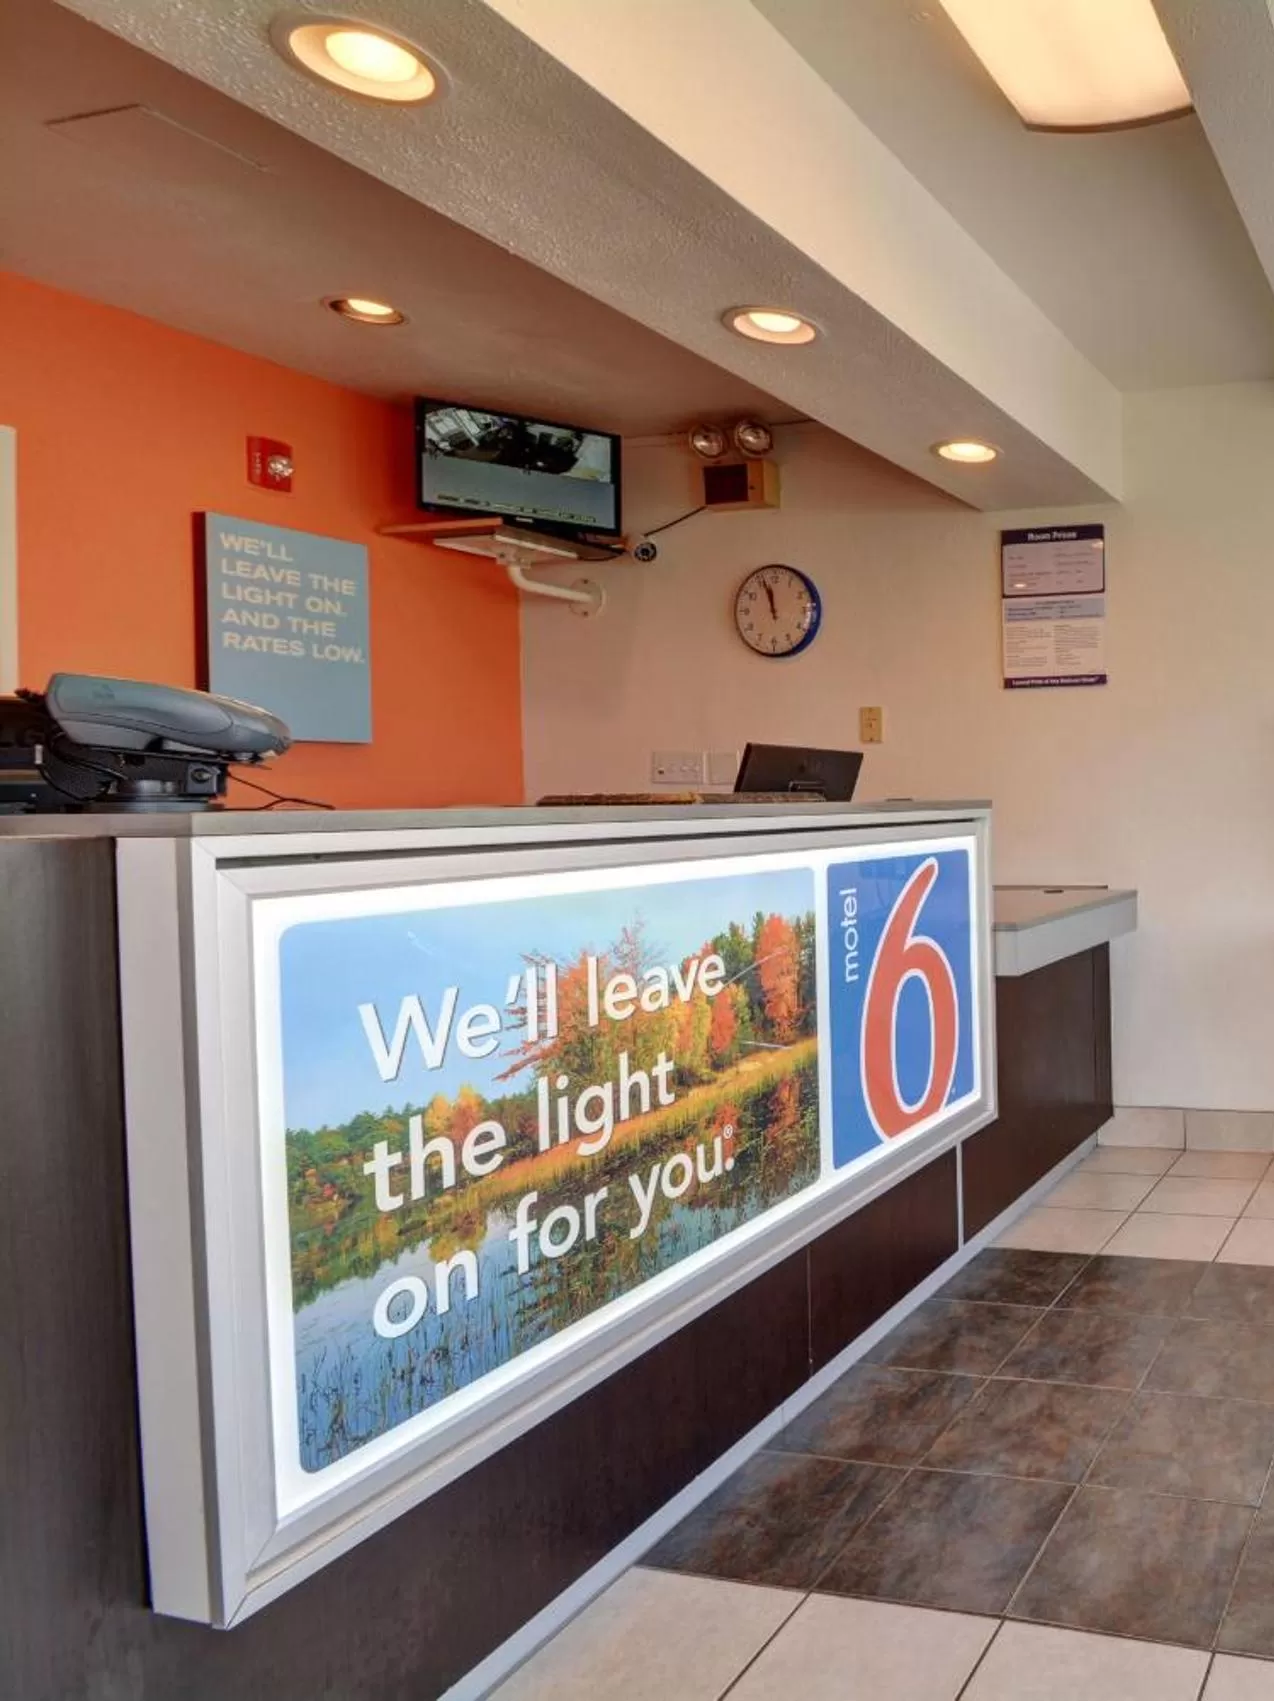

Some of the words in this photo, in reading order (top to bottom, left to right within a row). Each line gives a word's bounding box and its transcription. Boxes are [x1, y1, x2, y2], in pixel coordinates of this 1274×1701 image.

[220, 532, 294, 562] WE'LL
[221, 558, 302, 586] LEAVE
[308, 573, 357, 597] THE
[221, 583, 300, 609] LIGHT
[222, 608, 280, 630] AND
[287, 616, 337, 637] THE
[222, 632, 305, 657] RATES
[312, 643, 366, 664] LOW.
[839, 887, 858, 983] motel
[357, 960, 559, 1083] We'll
[587, 953, 726, 1028] leave
[860, 856, 960, 1143] 6
[363, 1113, 505, 1214] the
[538, 1051, 678, 1157] light
[372, 1248, 479, 1339] on
[509, 1185, 611, 1275] for
